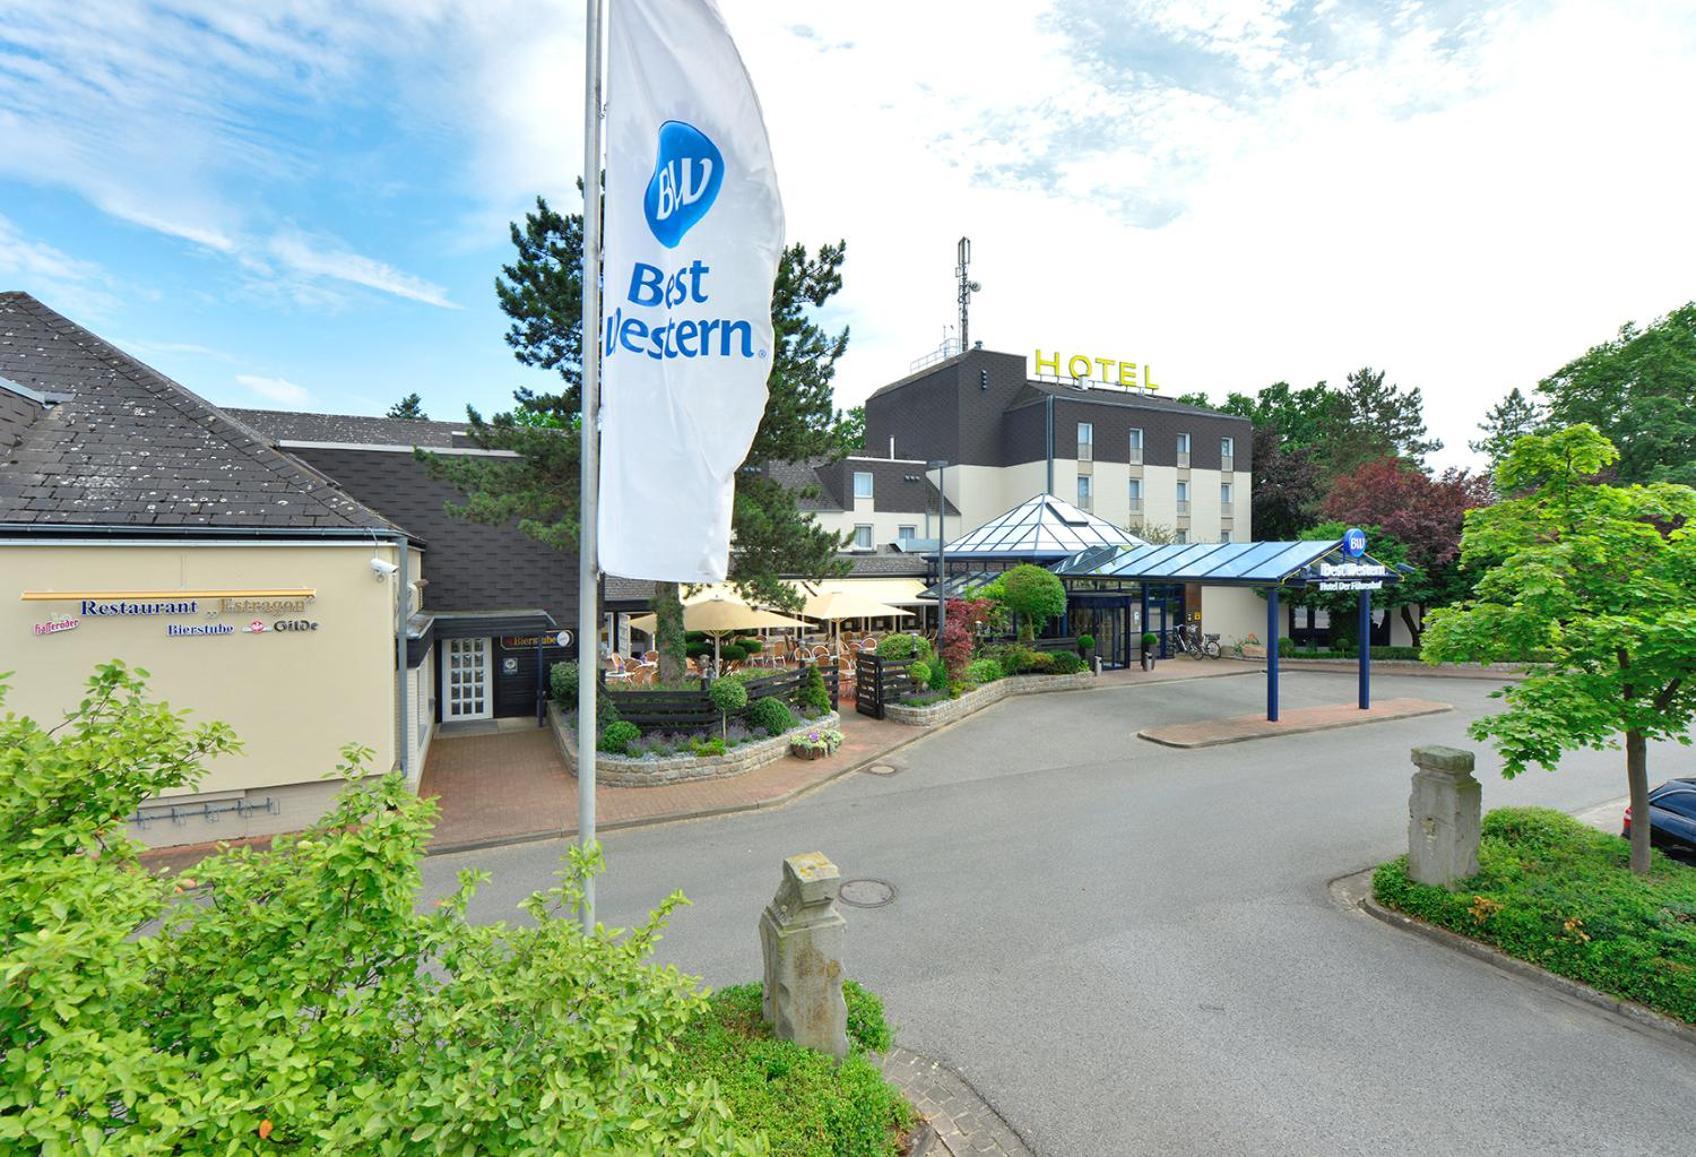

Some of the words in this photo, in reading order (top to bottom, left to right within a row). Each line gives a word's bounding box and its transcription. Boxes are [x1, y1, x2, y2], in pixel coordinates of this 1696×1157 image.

[656, 157, 714, 221] BW
[627, 260, 710, 309] Best
[1035, 349, 1159, 389] HOTEL
[1350, 537, 1366, 550] BW
[1320, 563, 1344, 576] Best
[1320, 582, 1338, 591] Hotel
[81, 600, 198, 616] Restaurant
[167, 623, 235, 637] Bierstube
[513, 636, 557, 646] Biersube
